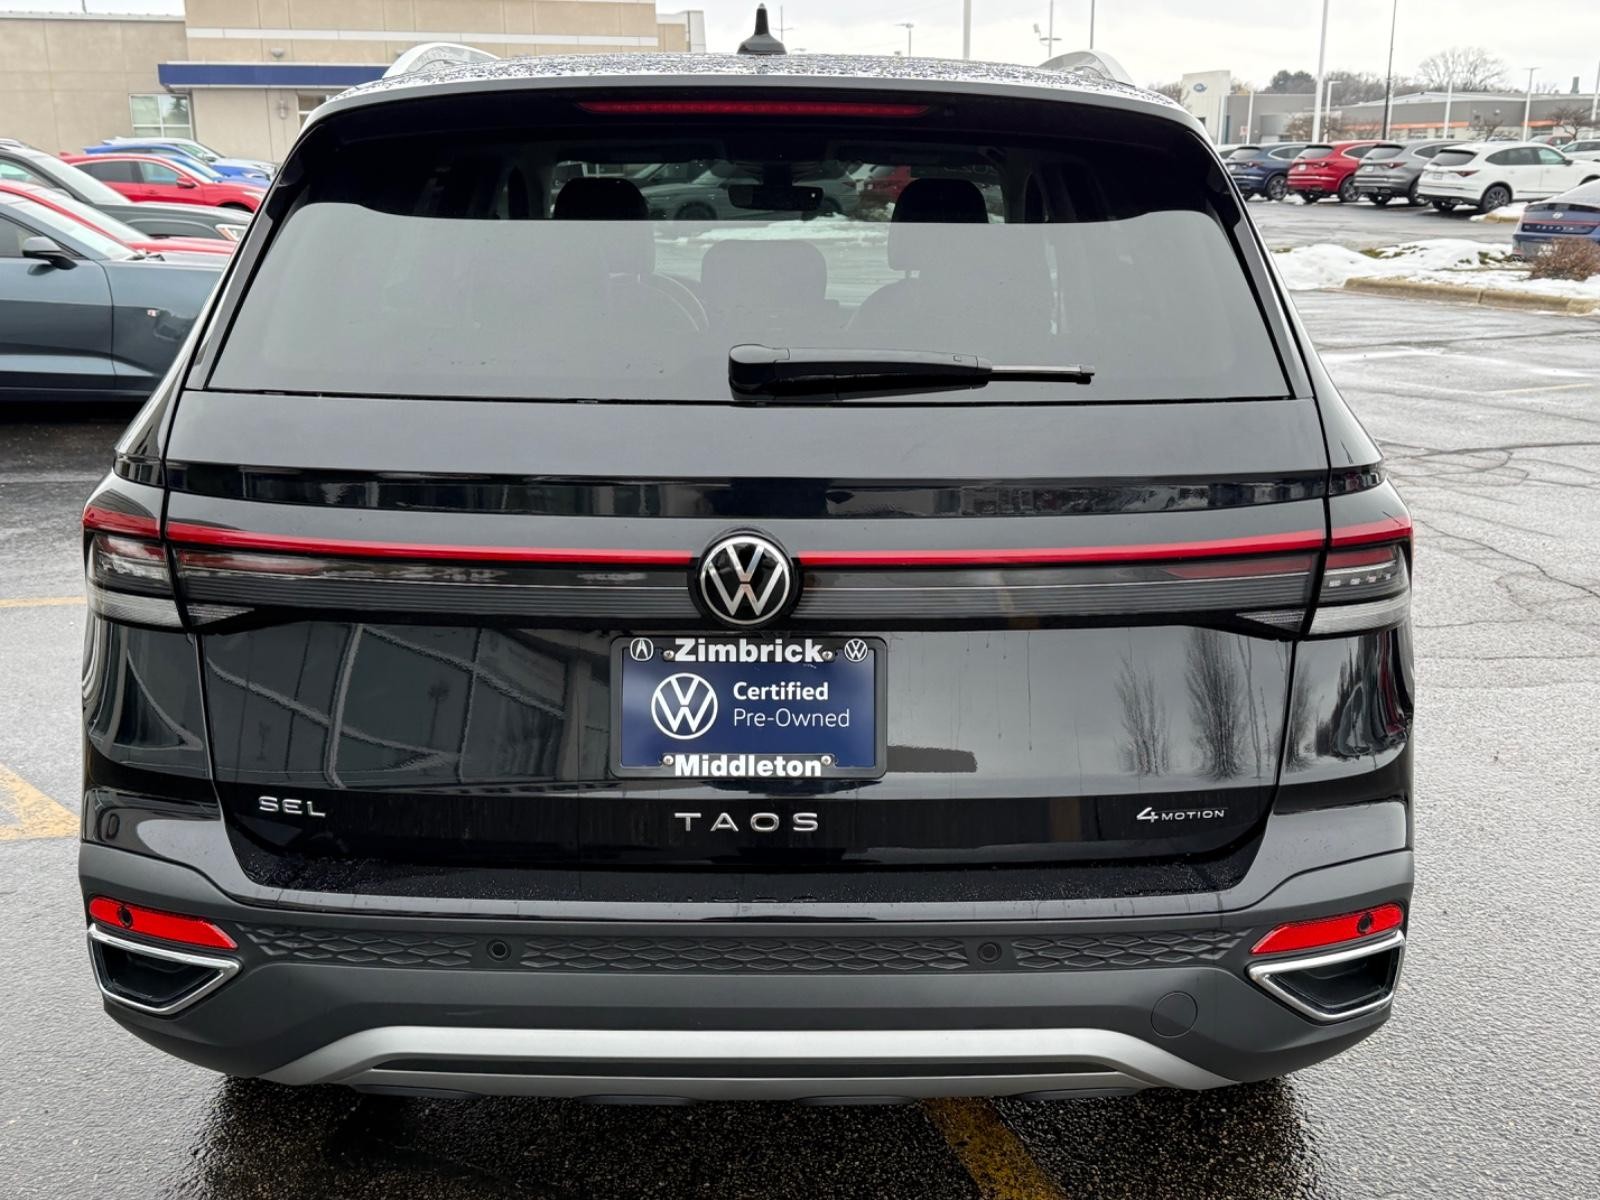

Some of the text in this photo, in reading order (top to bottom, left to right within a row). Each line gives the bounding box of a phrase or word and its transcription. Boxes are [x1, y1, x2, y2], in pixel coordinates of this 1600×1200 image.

[674, 638, 824, 663] Zimbrick
[733, 681, 829, 701] Certified
[733, 708, 850, 727] Pre-Owned
[674, 754, 822, 777] Middleton
[259, 795, 326, 818] SEL
[674, 812, 819, 832] TAOS
